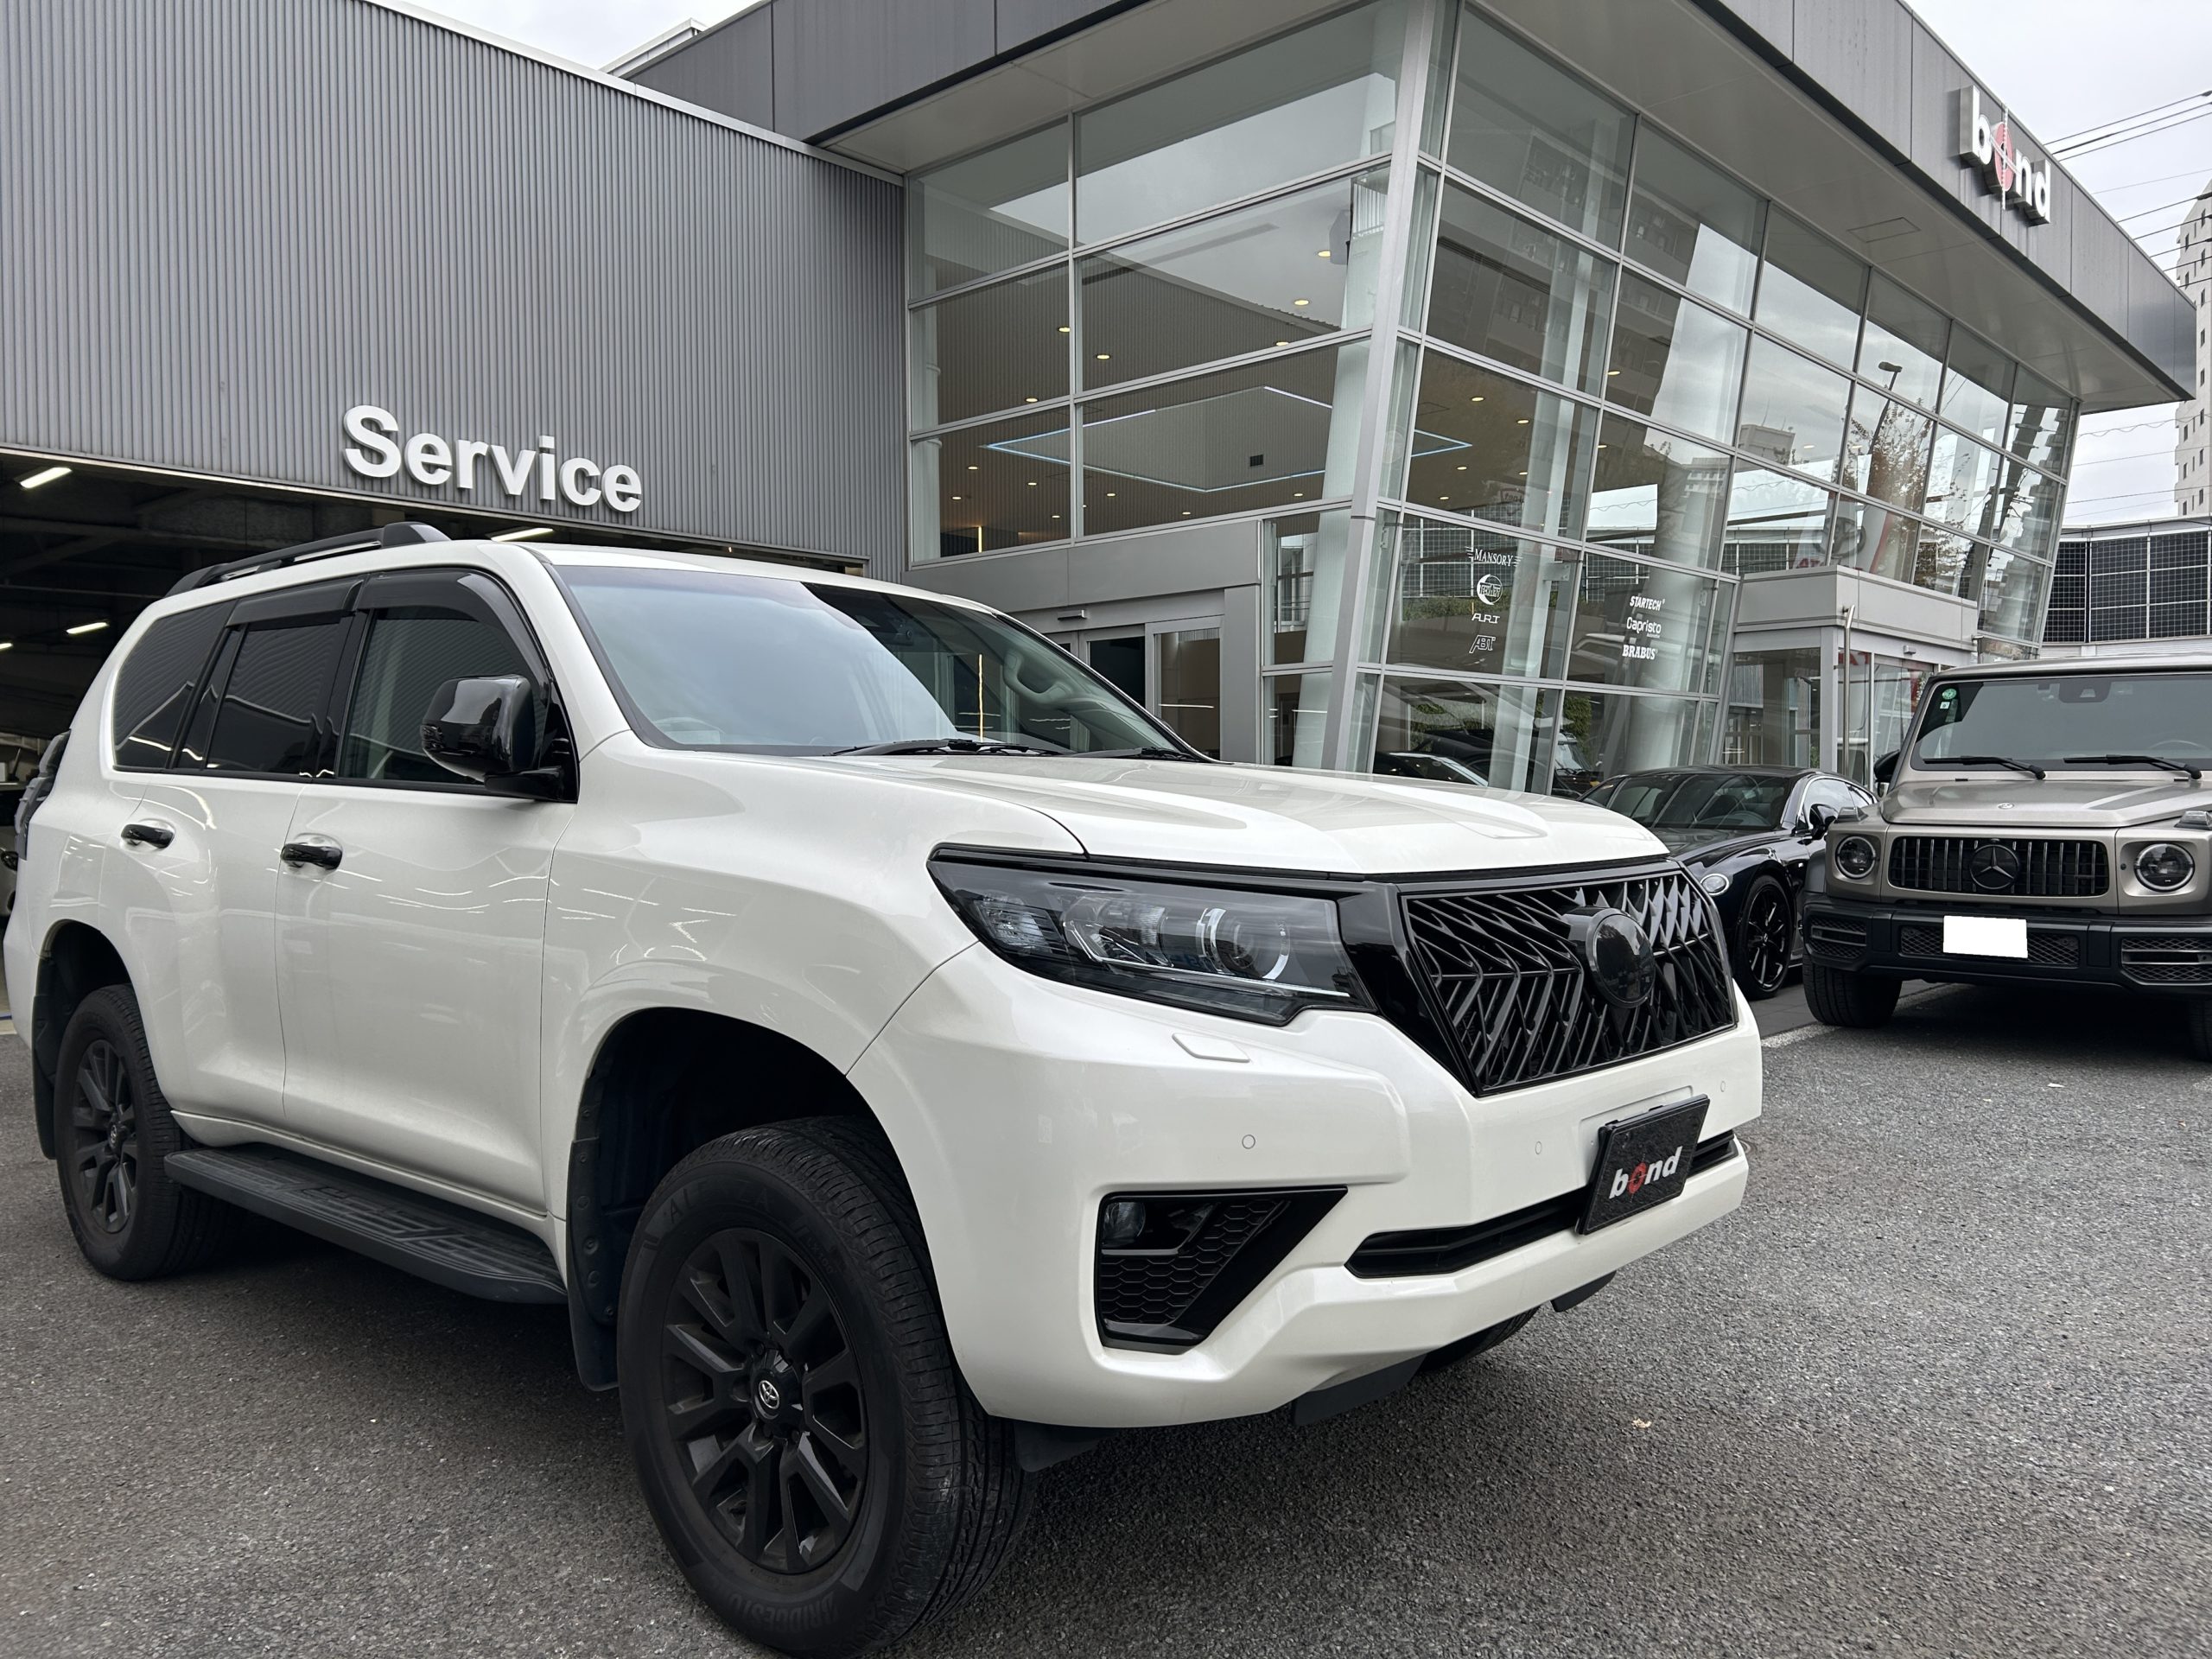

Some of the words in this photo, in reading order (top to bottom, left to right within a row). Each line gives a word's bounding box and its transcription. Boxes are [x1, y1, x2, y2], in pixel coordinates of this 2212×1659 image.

[343, 404, 642, 512] Service
[1626, 616, 1662, 634] Capristo
[1622, 644, 1656, 660] BRABUS
[1609, 1146, 1683, 1200] bond
